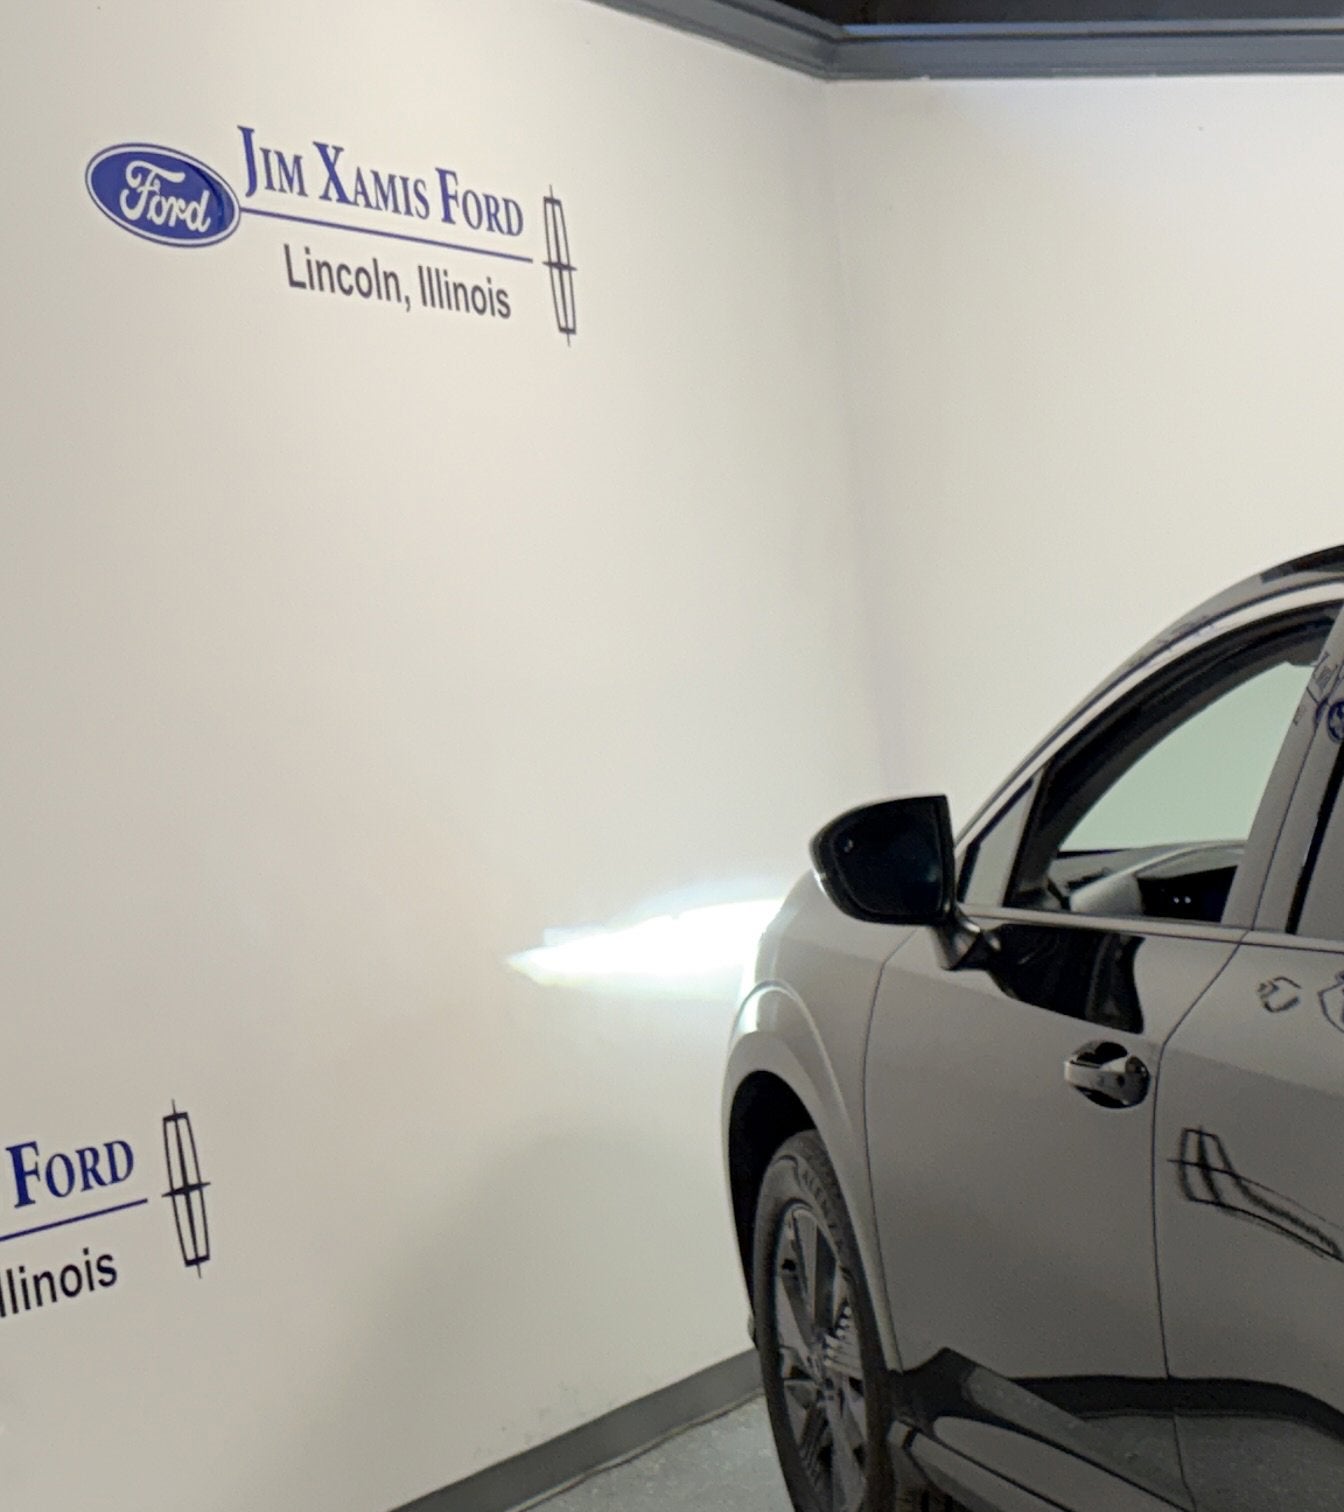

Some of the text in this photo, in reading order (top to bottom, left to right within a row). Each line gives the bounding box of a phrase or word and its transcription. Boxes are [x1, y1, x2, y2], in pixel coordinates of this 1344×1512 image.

[118, 160, 213, 233] Ford
[284, 244, 512, 319] Lincoln, Illinois
